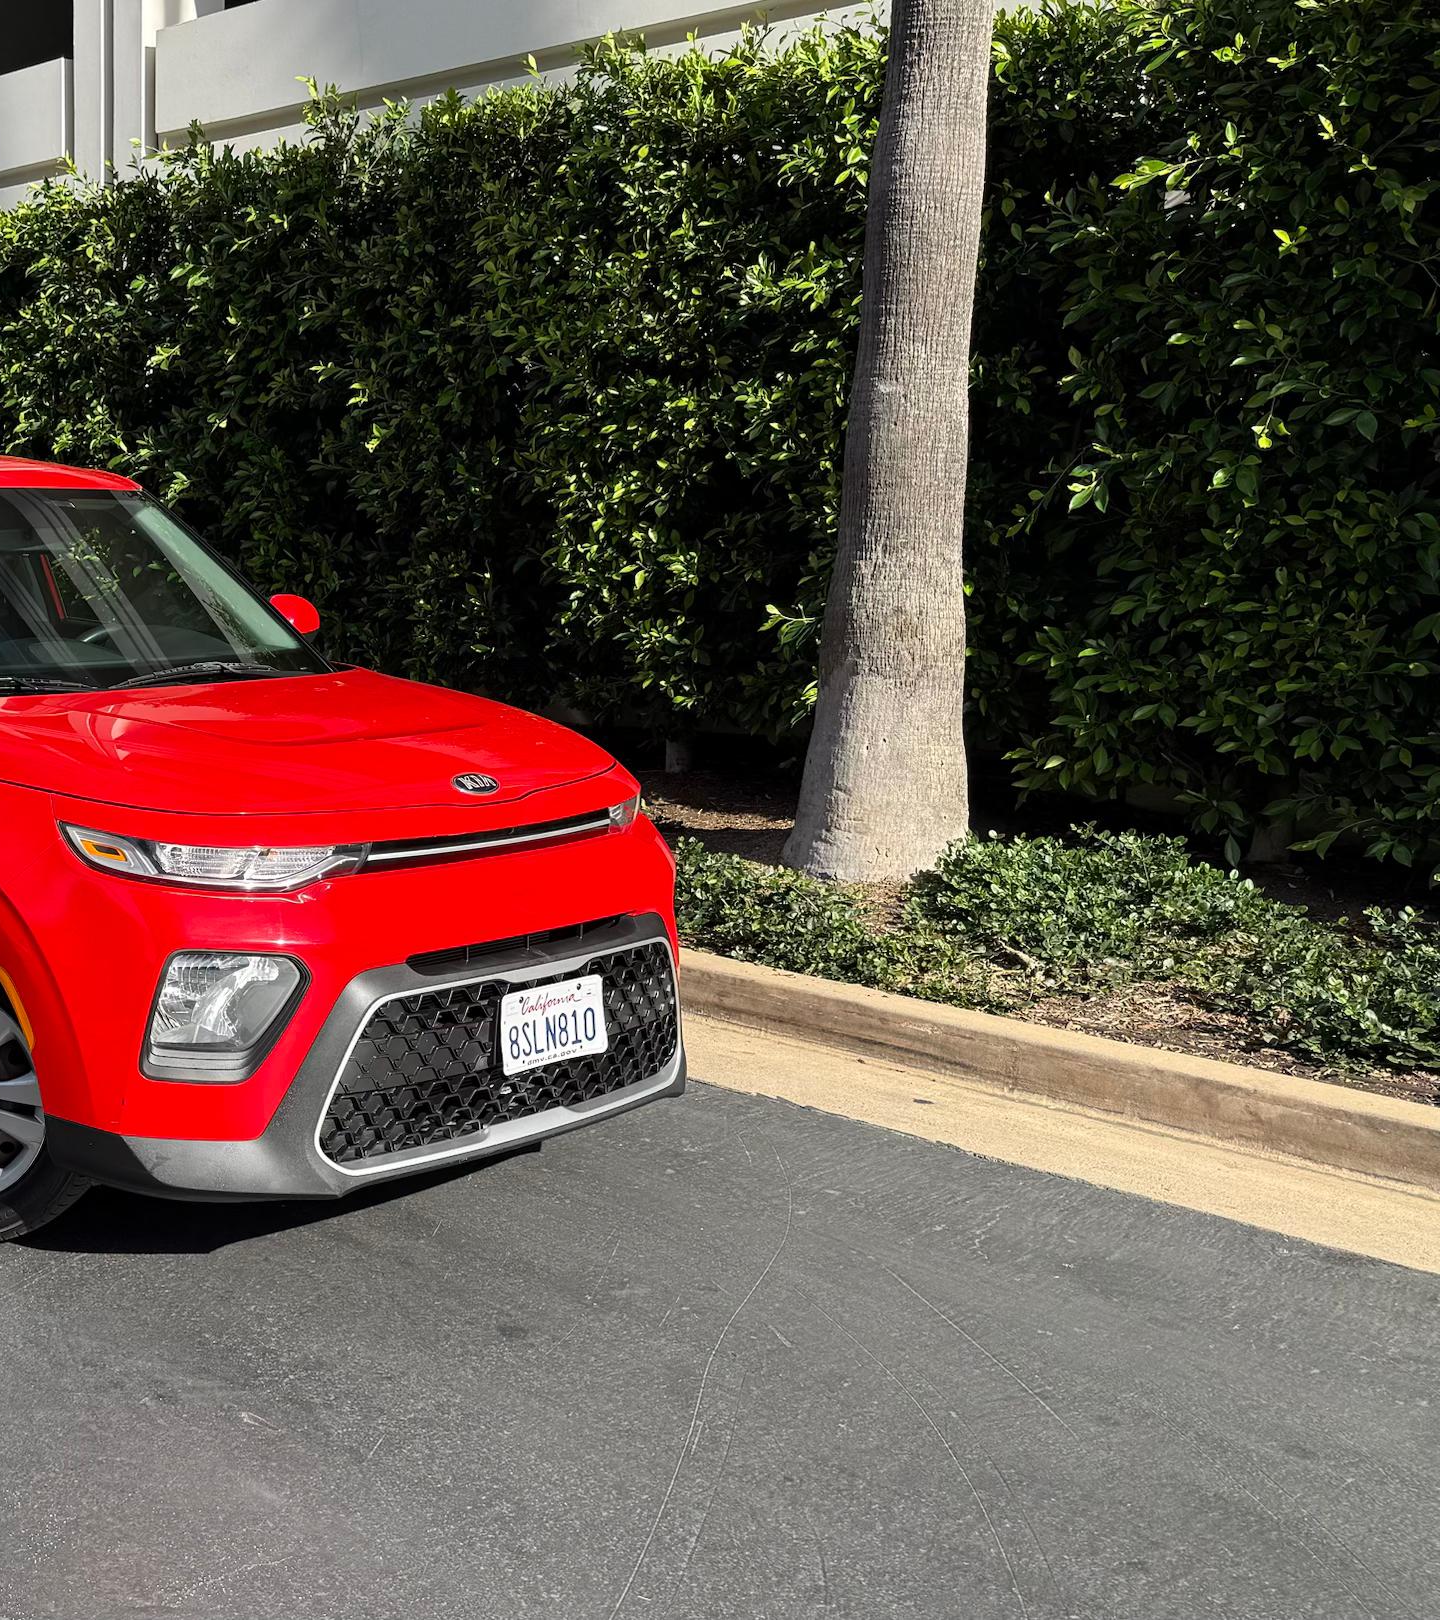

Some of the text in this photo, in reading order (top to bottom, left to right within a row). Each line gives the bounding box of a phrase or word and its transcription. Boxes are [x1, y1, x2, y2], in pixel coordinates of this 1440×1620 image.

[457, 774, 497, 790] KIA
[521, 991, 582, 1016] California
[509, 1007, 596, 1060] 8SLN810
[527, 1048, 578, 1066] dmv.ca.gov
